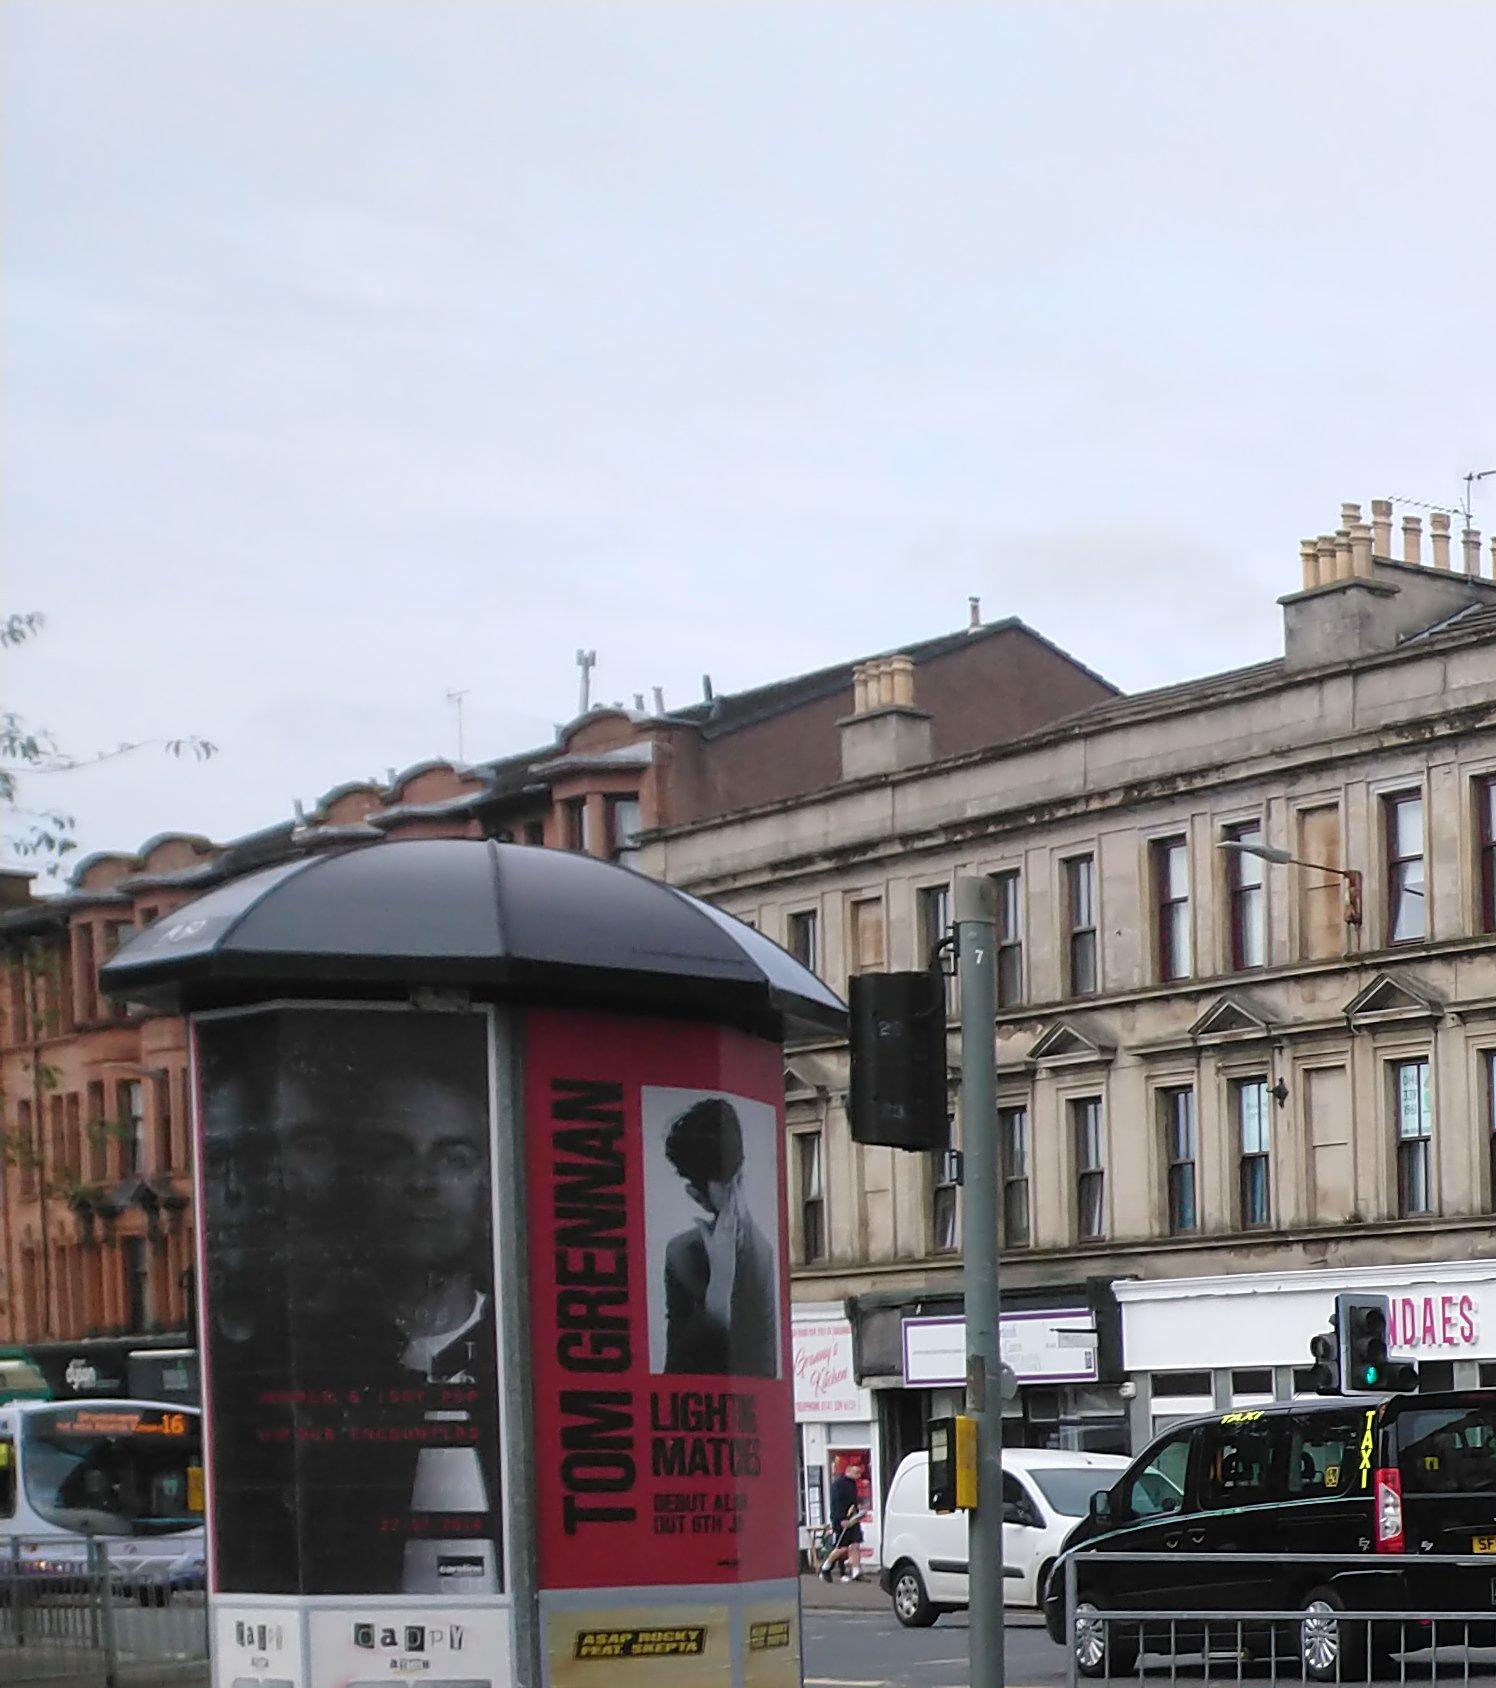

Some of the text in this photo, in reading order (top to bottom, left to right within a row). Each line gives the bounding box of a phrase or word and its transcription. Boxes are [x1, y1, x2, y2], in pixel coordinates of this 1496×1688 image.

[551, 1078, 632, 1374] GRENNAN
[560, 1391, 637, 1536] TOM
[1221, 1411, 1265, 1425] TAXI
[1359, 1410, 1376, 1488] TAXI
